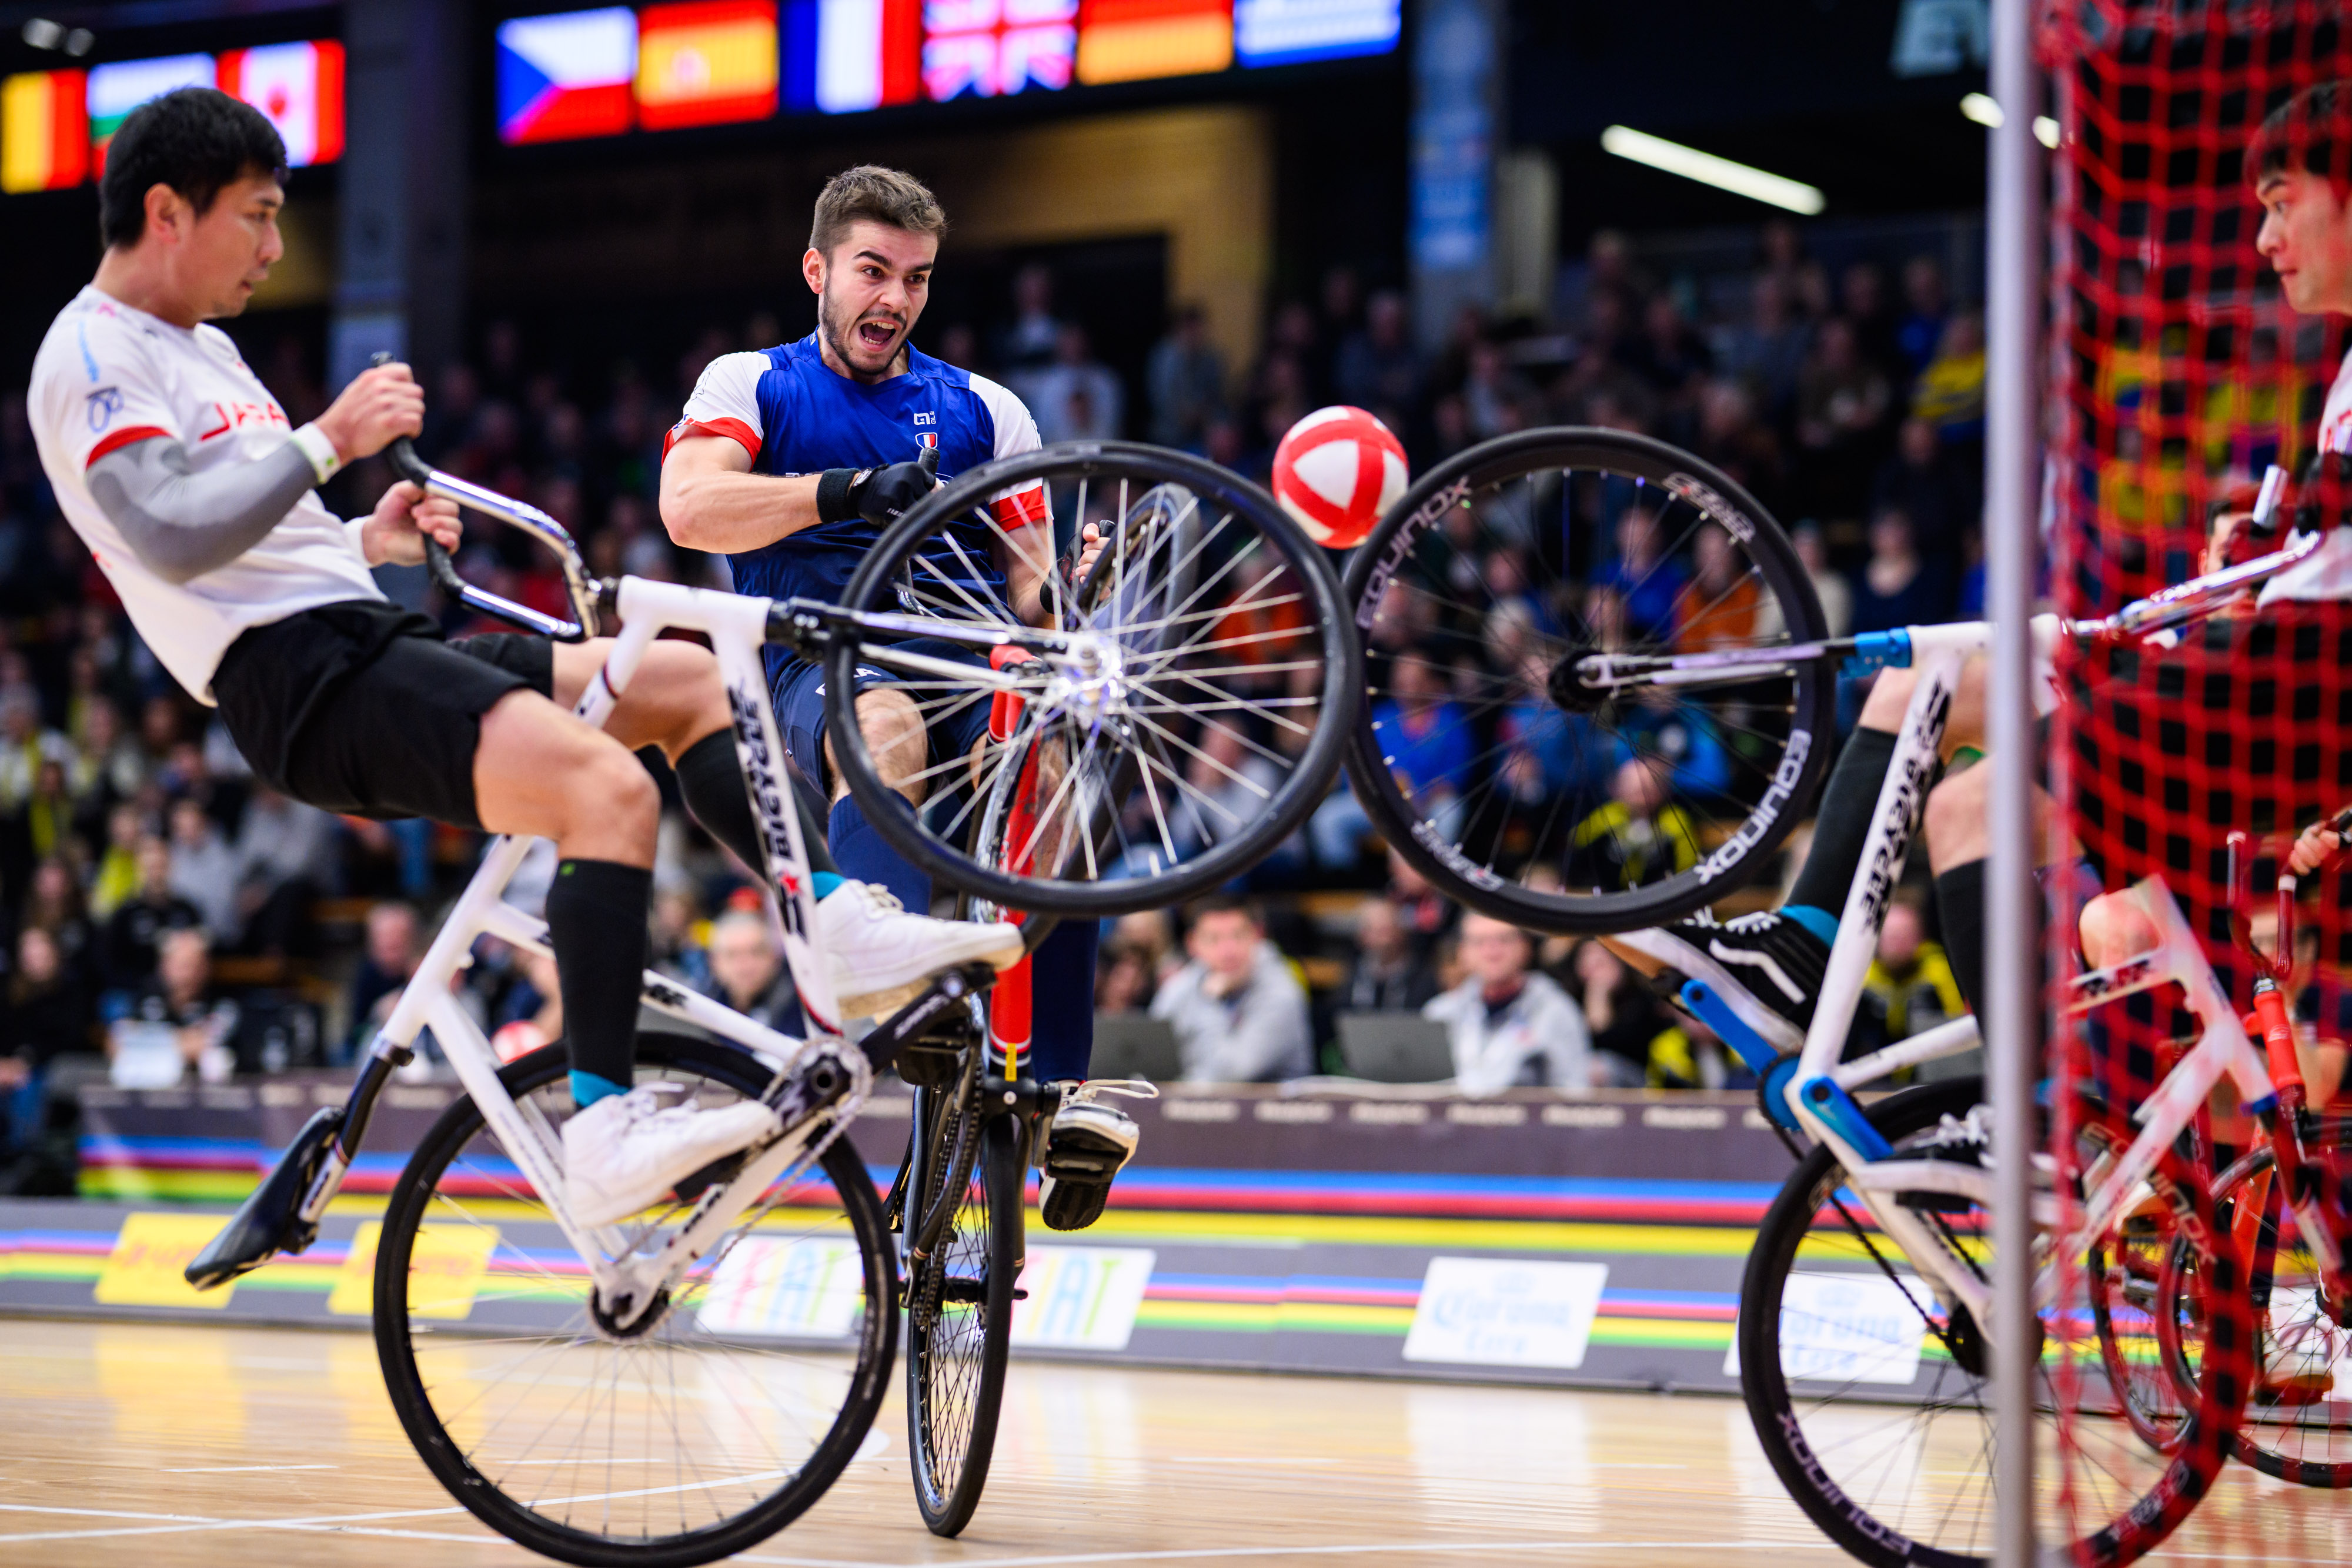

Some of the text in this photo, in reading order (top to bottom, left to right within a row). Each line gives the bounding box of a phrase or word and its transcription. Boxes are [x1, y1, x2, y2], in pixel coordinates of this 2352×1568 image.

[199, 402, 289, 442] JAPA
[1355, 474, 1473, 629] EQUINOX
[1692, 728, 1812, 884] EQUINOX
[1775, 1412, 1912, 1556] EQUINOX
